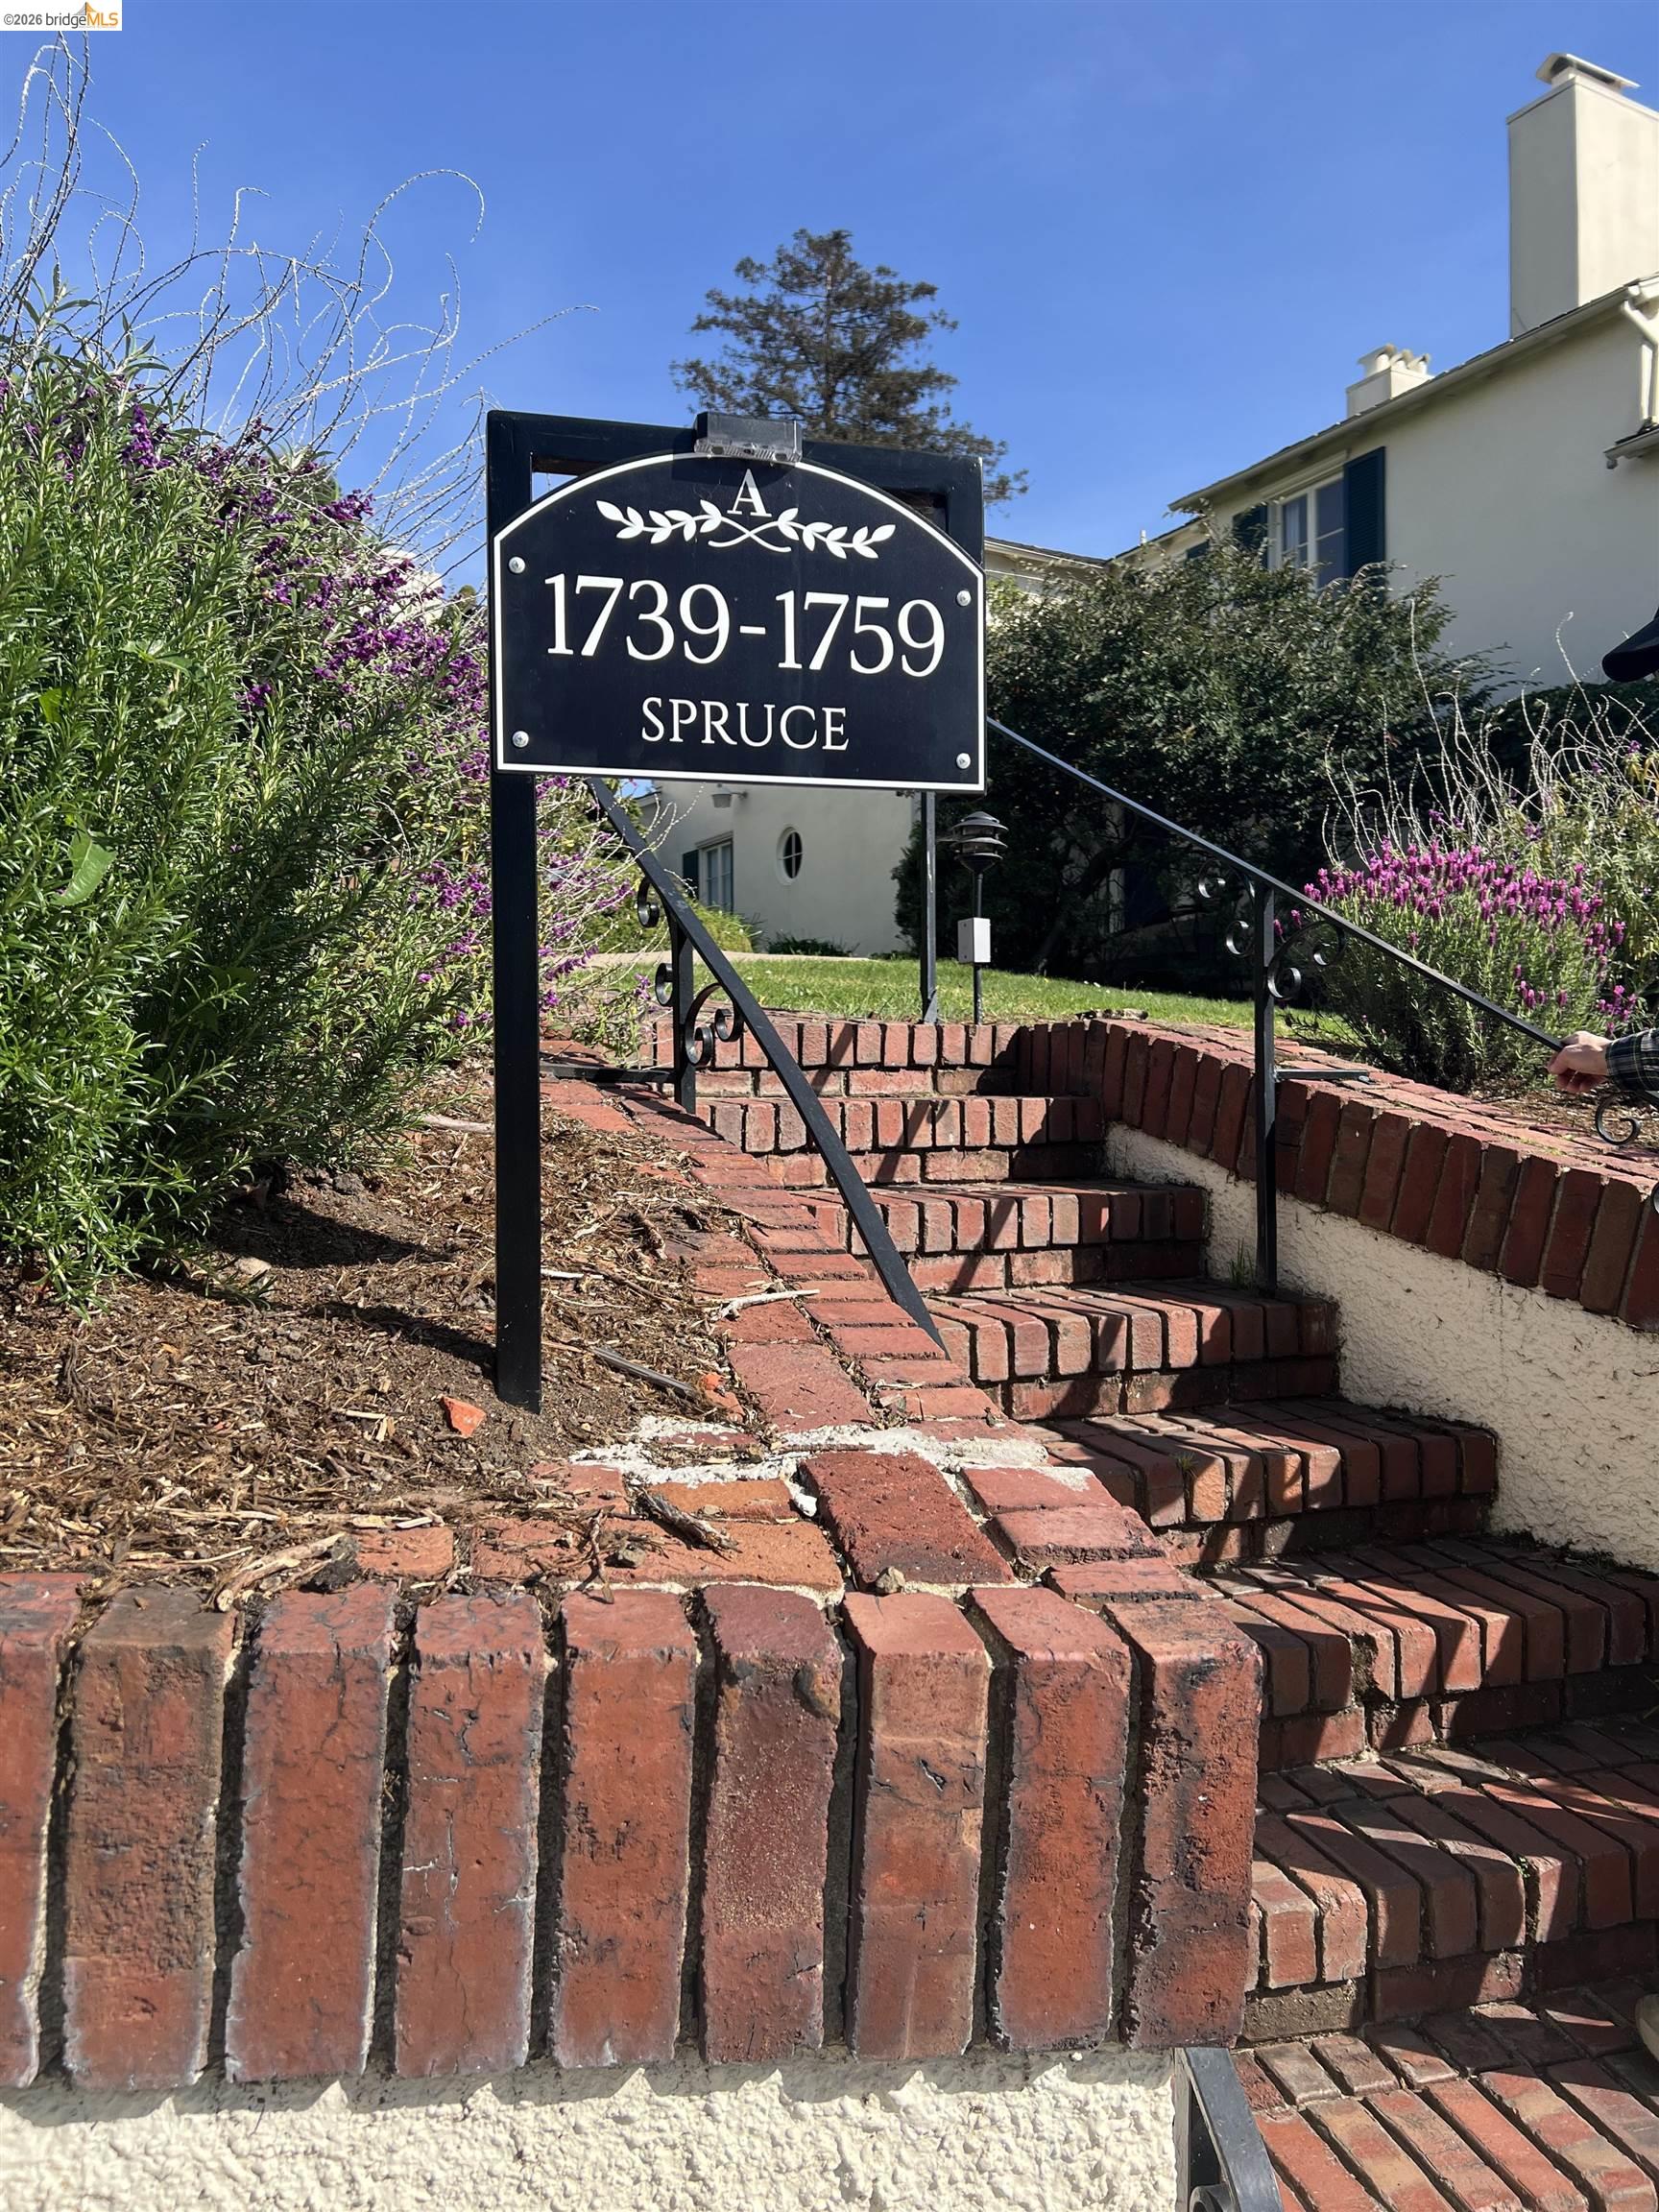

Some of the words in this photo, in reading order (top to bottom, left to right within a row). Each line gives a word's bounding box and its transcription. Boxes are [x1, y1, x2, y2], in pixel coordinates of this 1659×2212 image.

[726, 469, 772, 517] A
[544, 573, 945, 678] 1739-1759
[641, 696, 850, 751] SPRUCE
